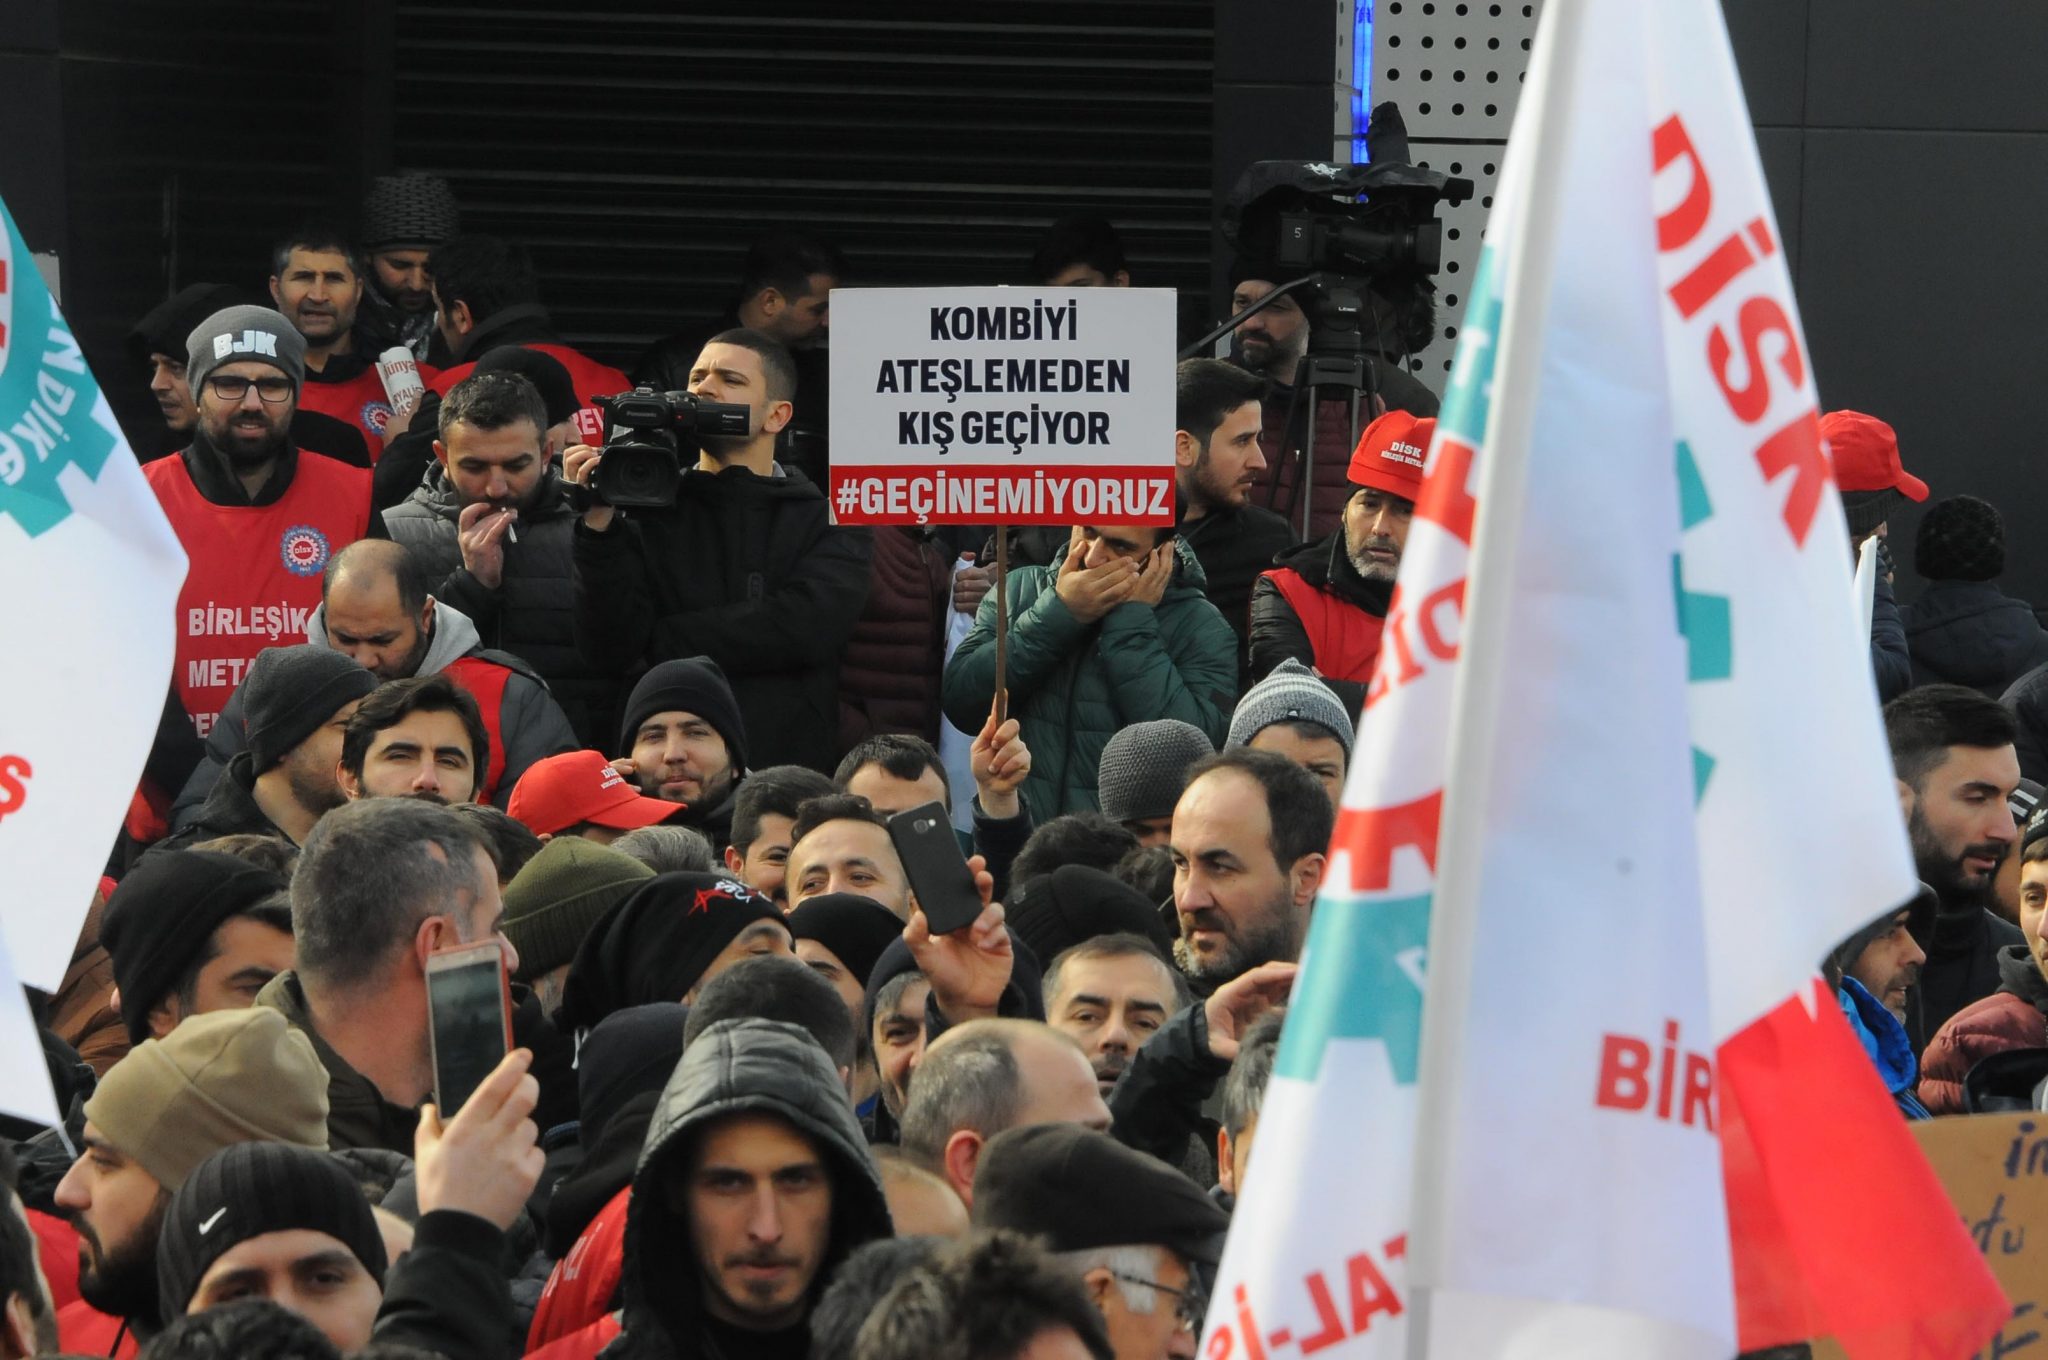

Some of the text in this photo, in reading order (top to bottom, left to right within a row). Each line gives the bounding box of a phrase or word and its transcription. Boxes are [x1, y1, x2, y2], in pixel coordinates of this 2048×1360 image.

[930, 298, 1077, 341] KOMBİYİ
[213, 329, 278, 360] BJK
[875, 358, 1130, 403] ATEŞLEMEDEN
[898, 403, 1110, 455] KIŞ GEÇİYOR
[1390, 441, 1422, 458] DİSK
[836, 470, 1170, 524] #GEÇİNEMİYORUZ
[188, 601, 310, 641] BİRLEŞİK
